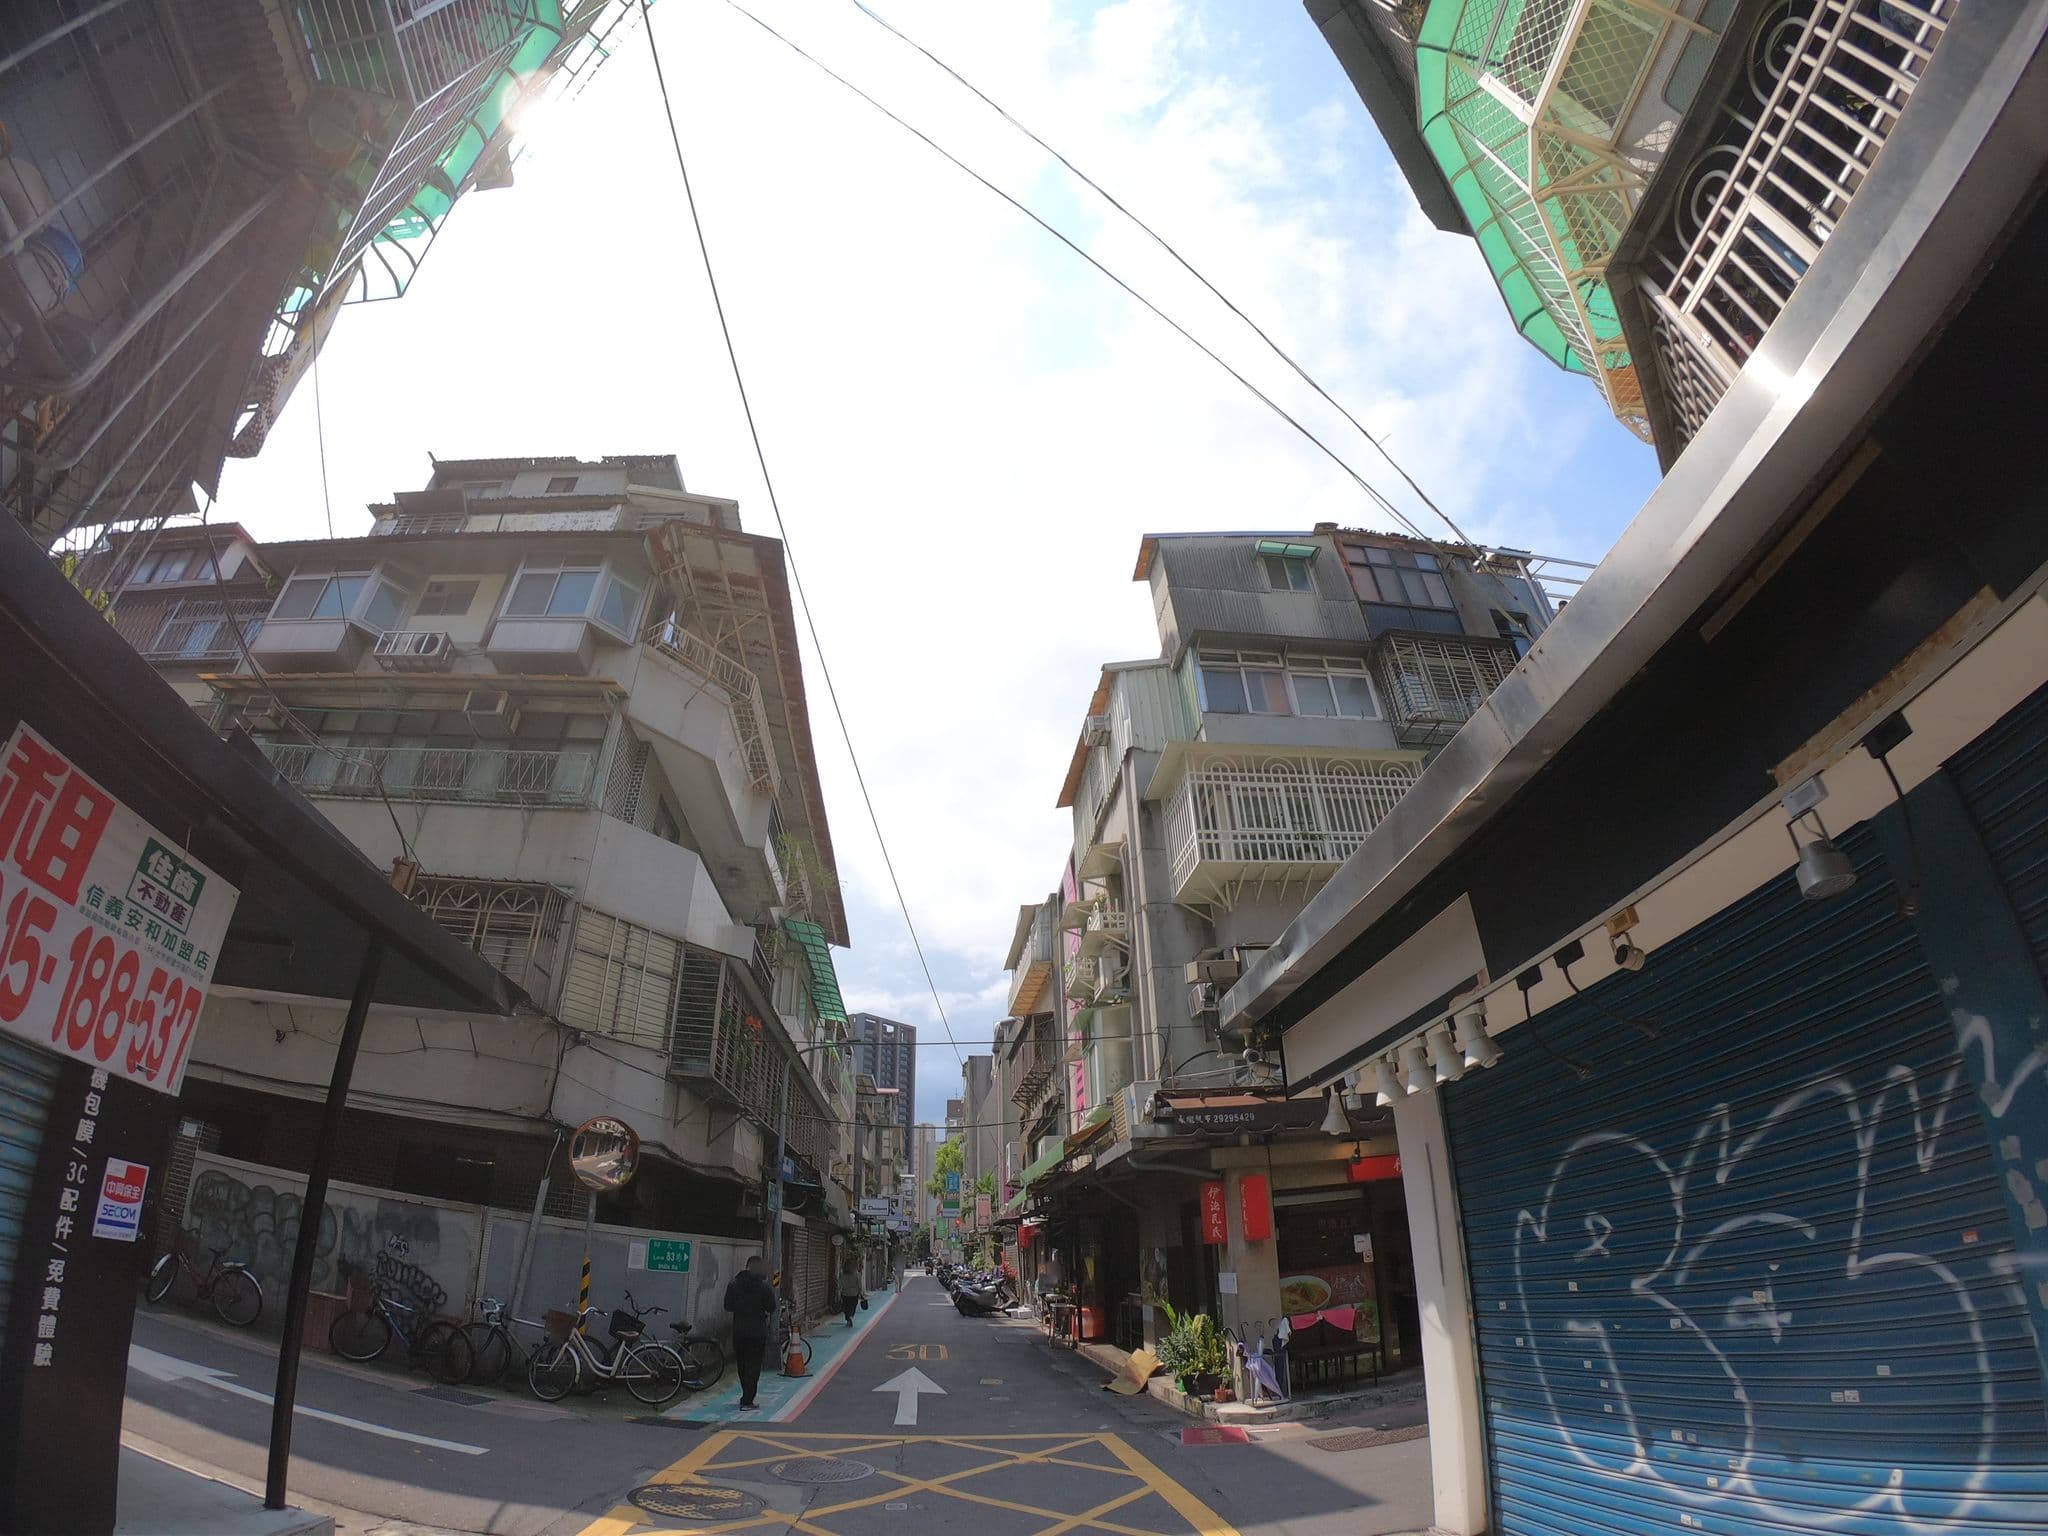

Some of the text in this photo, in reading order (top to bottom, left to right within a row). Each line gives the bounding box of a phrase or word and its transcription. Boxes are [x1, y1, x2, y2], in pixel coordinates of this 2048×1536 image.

[147, 848, 200, 901] 住商
[86, 883, 211, 970] 信義安和加盟店
[137, 879, 188, 926] 不動產
[0, 870, 202, 1088] 15-188-537
[101, 1204, 136, 1221] SECOM
[885, 1343, 950, 1360] 30
